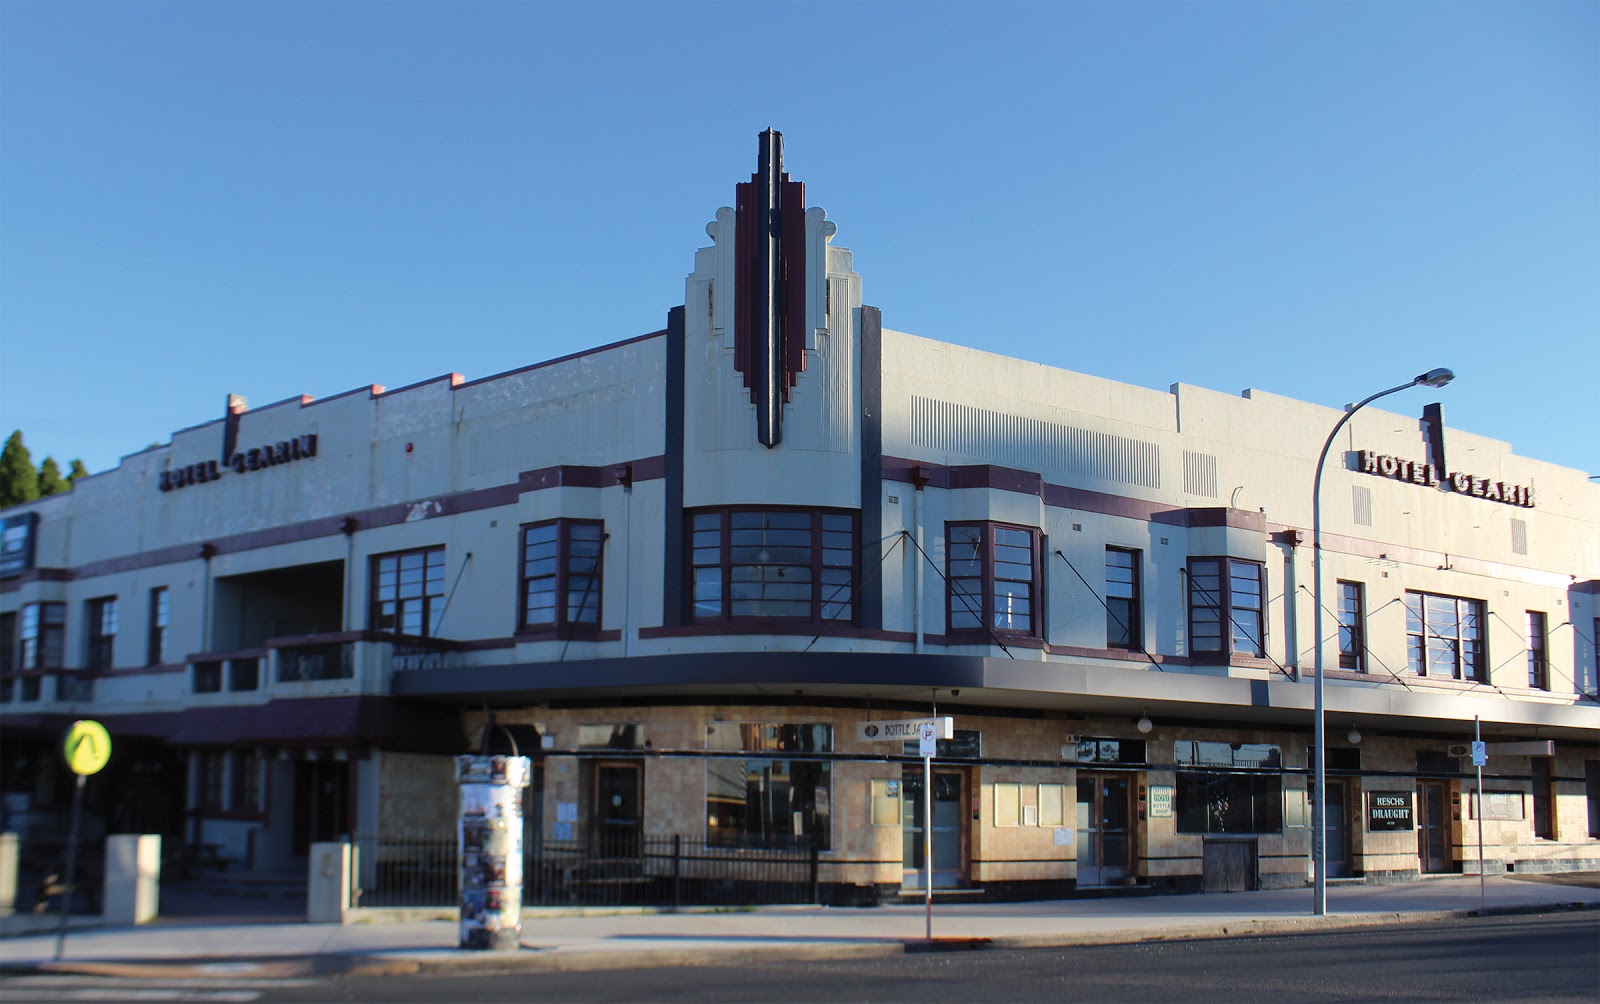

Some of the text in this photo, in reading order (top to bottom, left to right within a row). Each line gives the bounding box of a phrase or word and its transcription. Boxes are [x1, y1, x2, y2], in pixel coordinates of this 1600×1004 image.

[1360, 449, 1440, 487] HOTEL
[885, 723, 911, 737] BOTTLE
[1376, 797, 1405, 806] RESCHS
[1372, 809, 1410, 819] DRAUGHT
